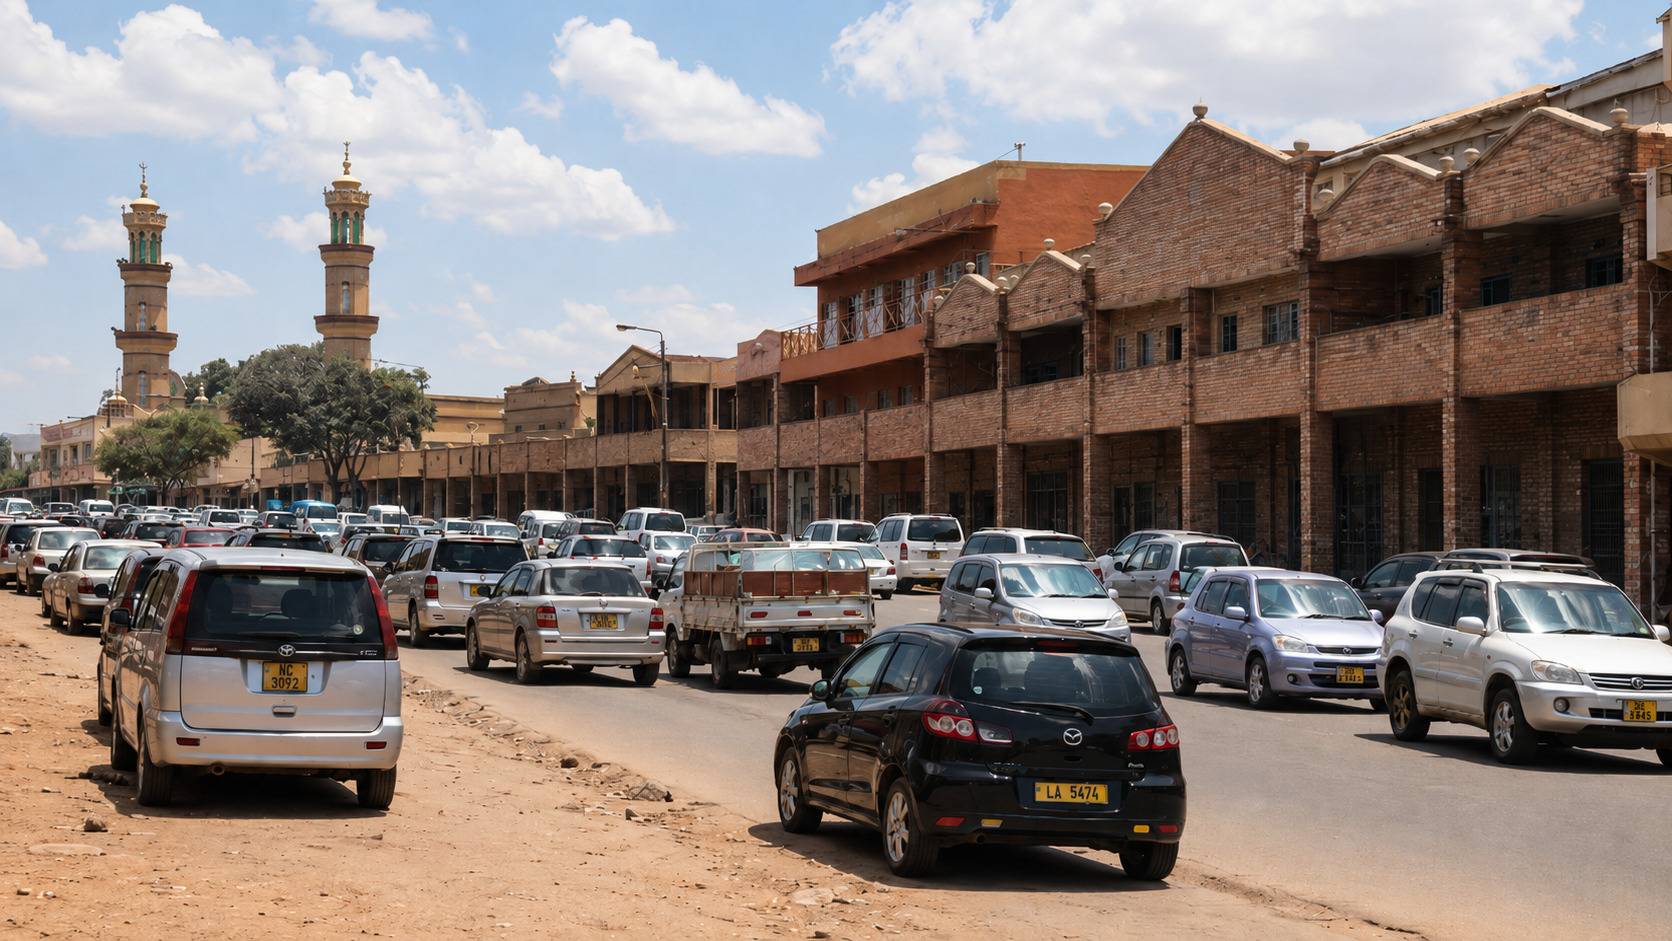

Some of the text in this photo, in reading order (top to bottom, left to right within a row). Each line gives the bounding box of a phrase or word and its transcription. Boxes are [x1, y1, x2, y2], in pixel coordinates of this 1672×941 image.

[280, 663, 293, 676] NC
[271, 677, 299, 689] 3092
[1046, 785, 1099, 800] LA 5474
